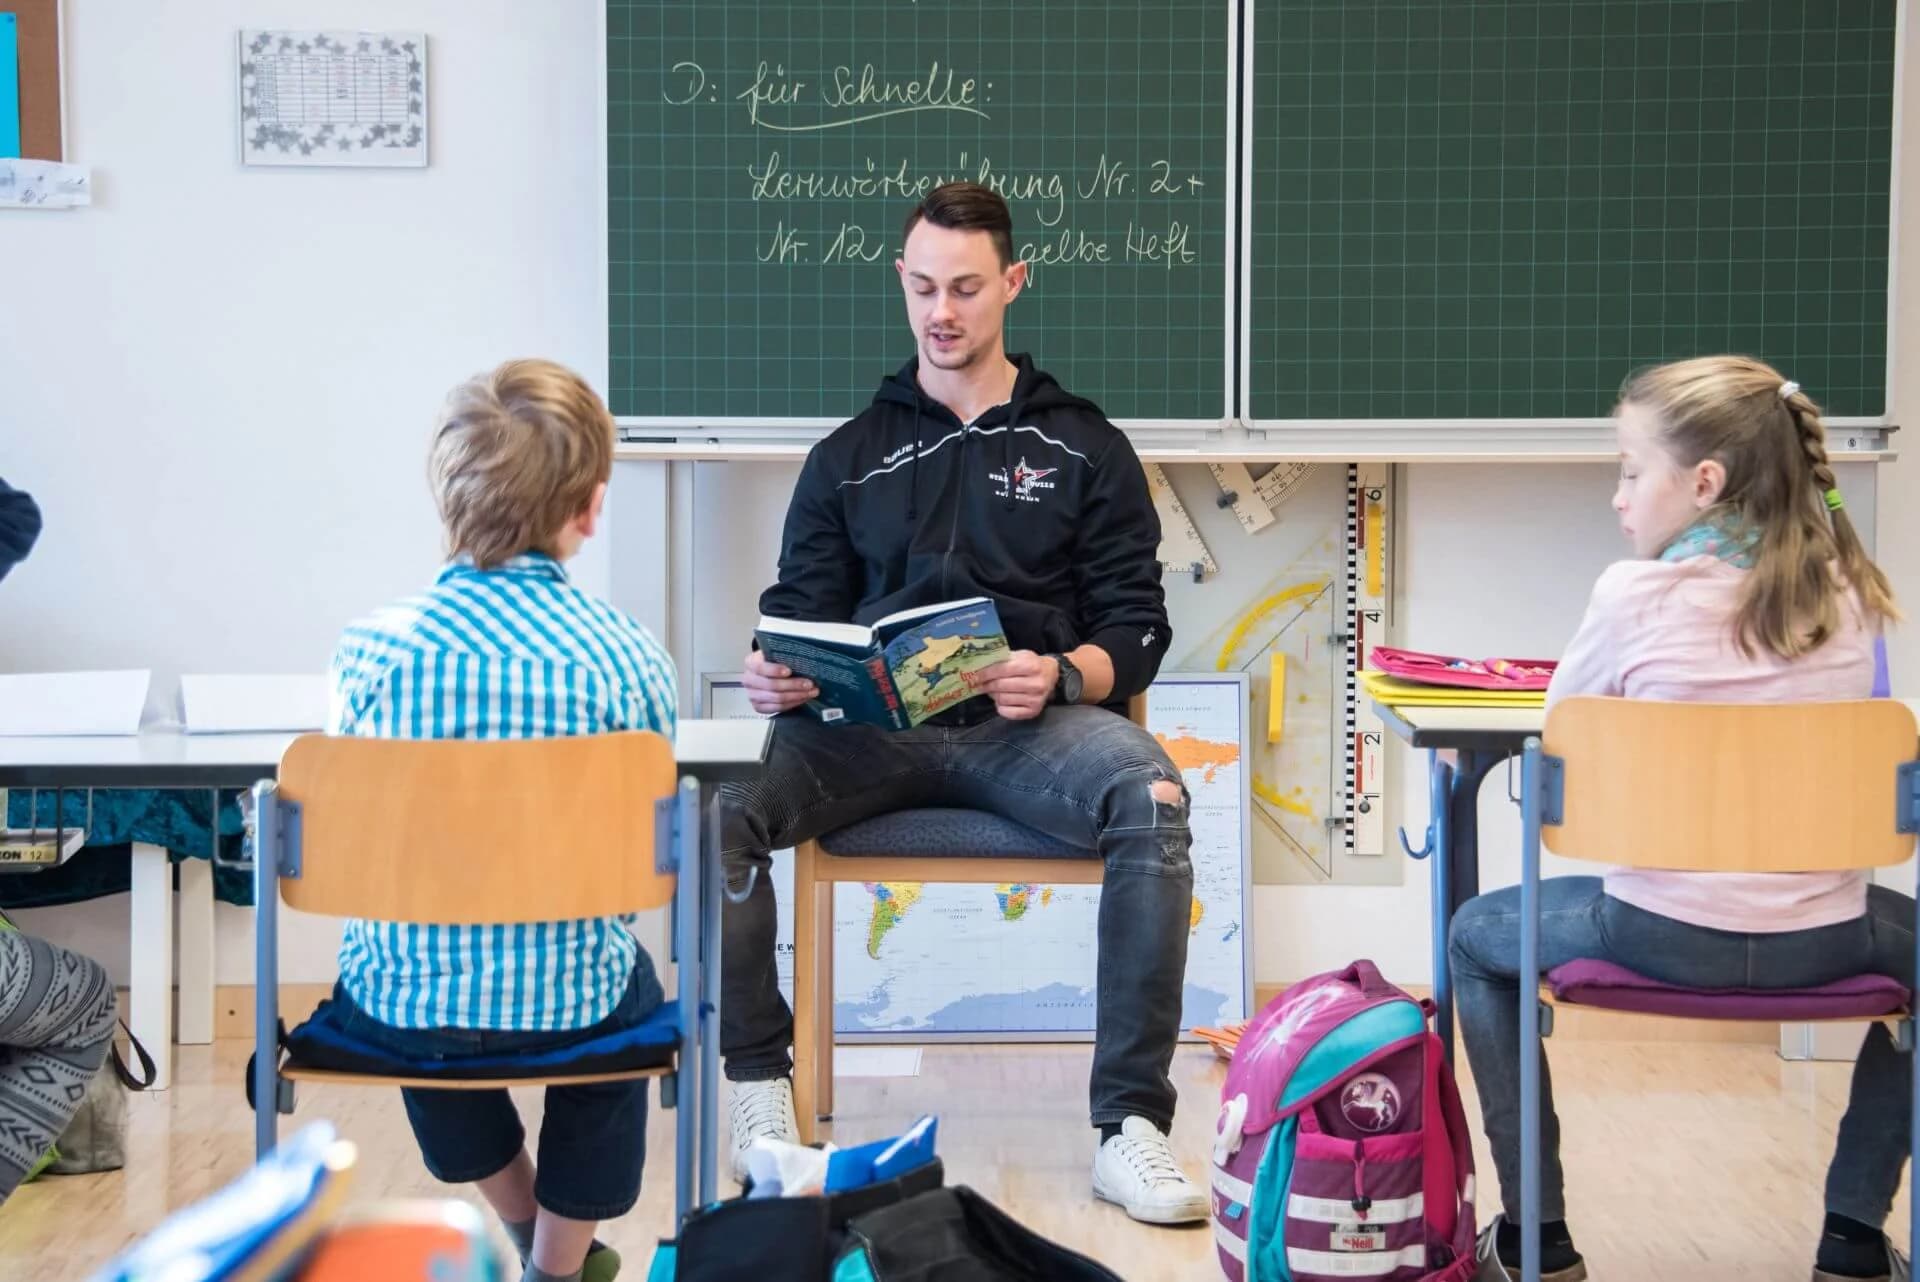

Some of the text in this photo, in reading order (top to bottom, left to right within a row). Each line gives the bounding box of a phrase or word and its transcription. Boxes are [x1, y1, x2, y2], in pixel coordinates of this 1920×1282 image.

[736, 61, 805, 125] für
[822, 61, 993, 107] Schnelle:
[1078, 154, 1135, 198] Nr.
[757, 220, 1196, 288] Nr. 12 gelbe Heft
[1365, 611, 1381, 623] 4
[1364, 733, 1380, 746] 2
